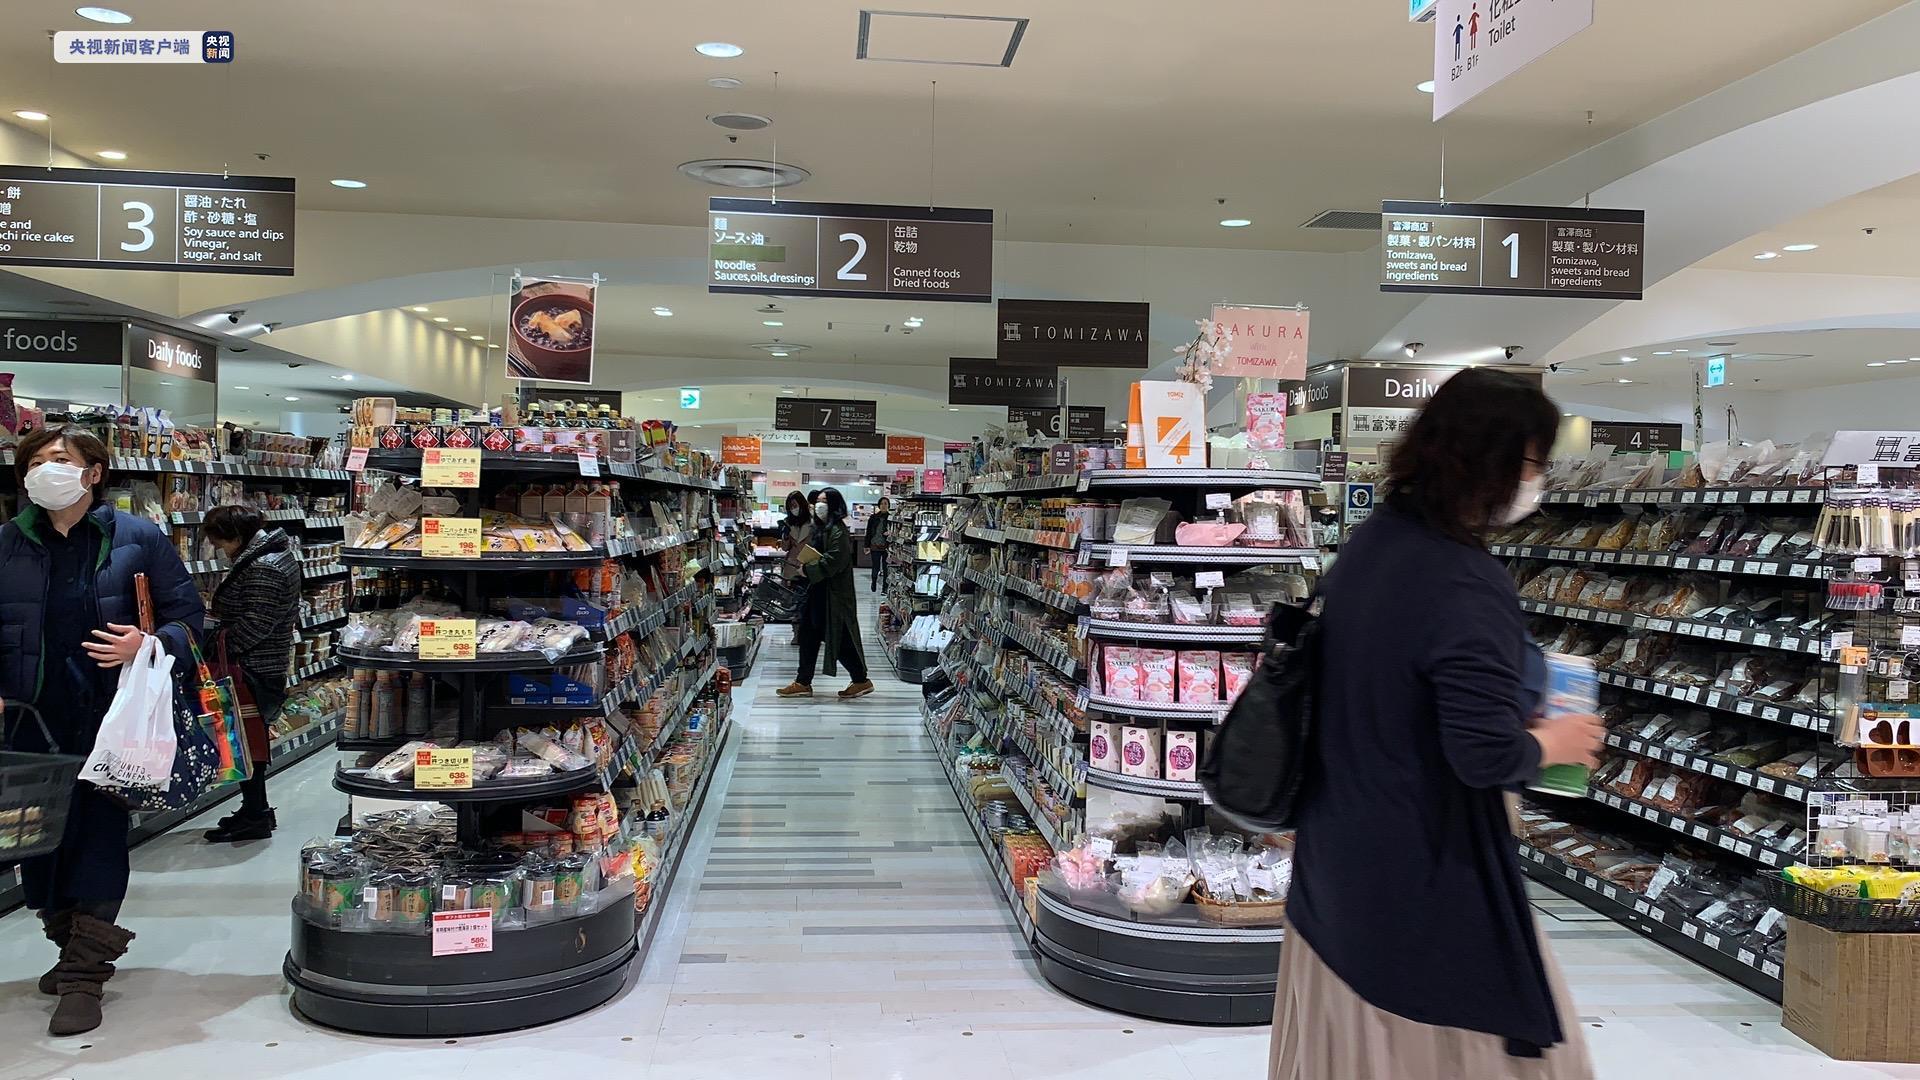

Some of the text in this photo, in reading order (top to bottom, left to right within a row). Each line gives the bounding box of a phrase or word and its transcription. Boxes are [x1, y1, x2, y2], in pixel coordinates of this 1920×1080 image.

[1488, 15, 1516, 47] Toilet
[1467, 54, 1479, 71] B1F
[1451, 65, 1464, 82] B2F
[184, 194, 246, 210] 醤油・たれ
[10, 219, 32, 230] and
[184, 209, 257, 226] 酢・砂糖・塩
[119, 200, 155, 252] 3
[893, 226, 918, 240] 缶詰
[22, 232, 42, 242] rice
[44, 234, 75, 245] cakes
[184, 226, 284, 243] Soy sauce and dips
[714, 232, 765, 246] ソース・油
[1386, 234, 1476, 250] 製菓・製パン材料
[184, 238, 230, 252] Vinegar,
[893, 241, 918, 255] 乾物
[1551, 240, 1639, 256] 製菓・製パン材料
[183, 251, 262, 263] sugar, and salt
[837, 233, 867, 281] 2
[1386, 250, 1437, 261] Tomizawa,
[1501, 232, 1520, 279] 1
[1551, 255, 1600, 267] Tomizawa,
[714, 259, 757, 271] Noodles
[1386, 261, 1467, 272] sweets and bread
[1551, 267, 1630, 278] sweets and bread
[714, 271, 815, 286] Sauces,oils,dressings
[893, 267, 961, 280] Canned foods
[1386, 271, 1439, 283] ingredients
[893, 278, 950, 290] Dried foods
[1551, 277, 1602, 288] ingredients
[1032, 325, 1143, 342] TOMIZAWA
[1215, 322, 1303, 340] SAKURA
[3, 327, 78, 352] foods
[147, 339, 203, 370] Daily foods
[1236, 356, 1278, 368] TOMIZAWA
[974, 376, 1054, 390] TOMIZAWA
[1289, 381, 1329, 408] Daily foods
[820, 408, 833, 427] 7
[1253, 406, 1280, 414] SAKURA
[1050, 414, 1060, 433] 6
[1630, 431, 1643, 449] 4
